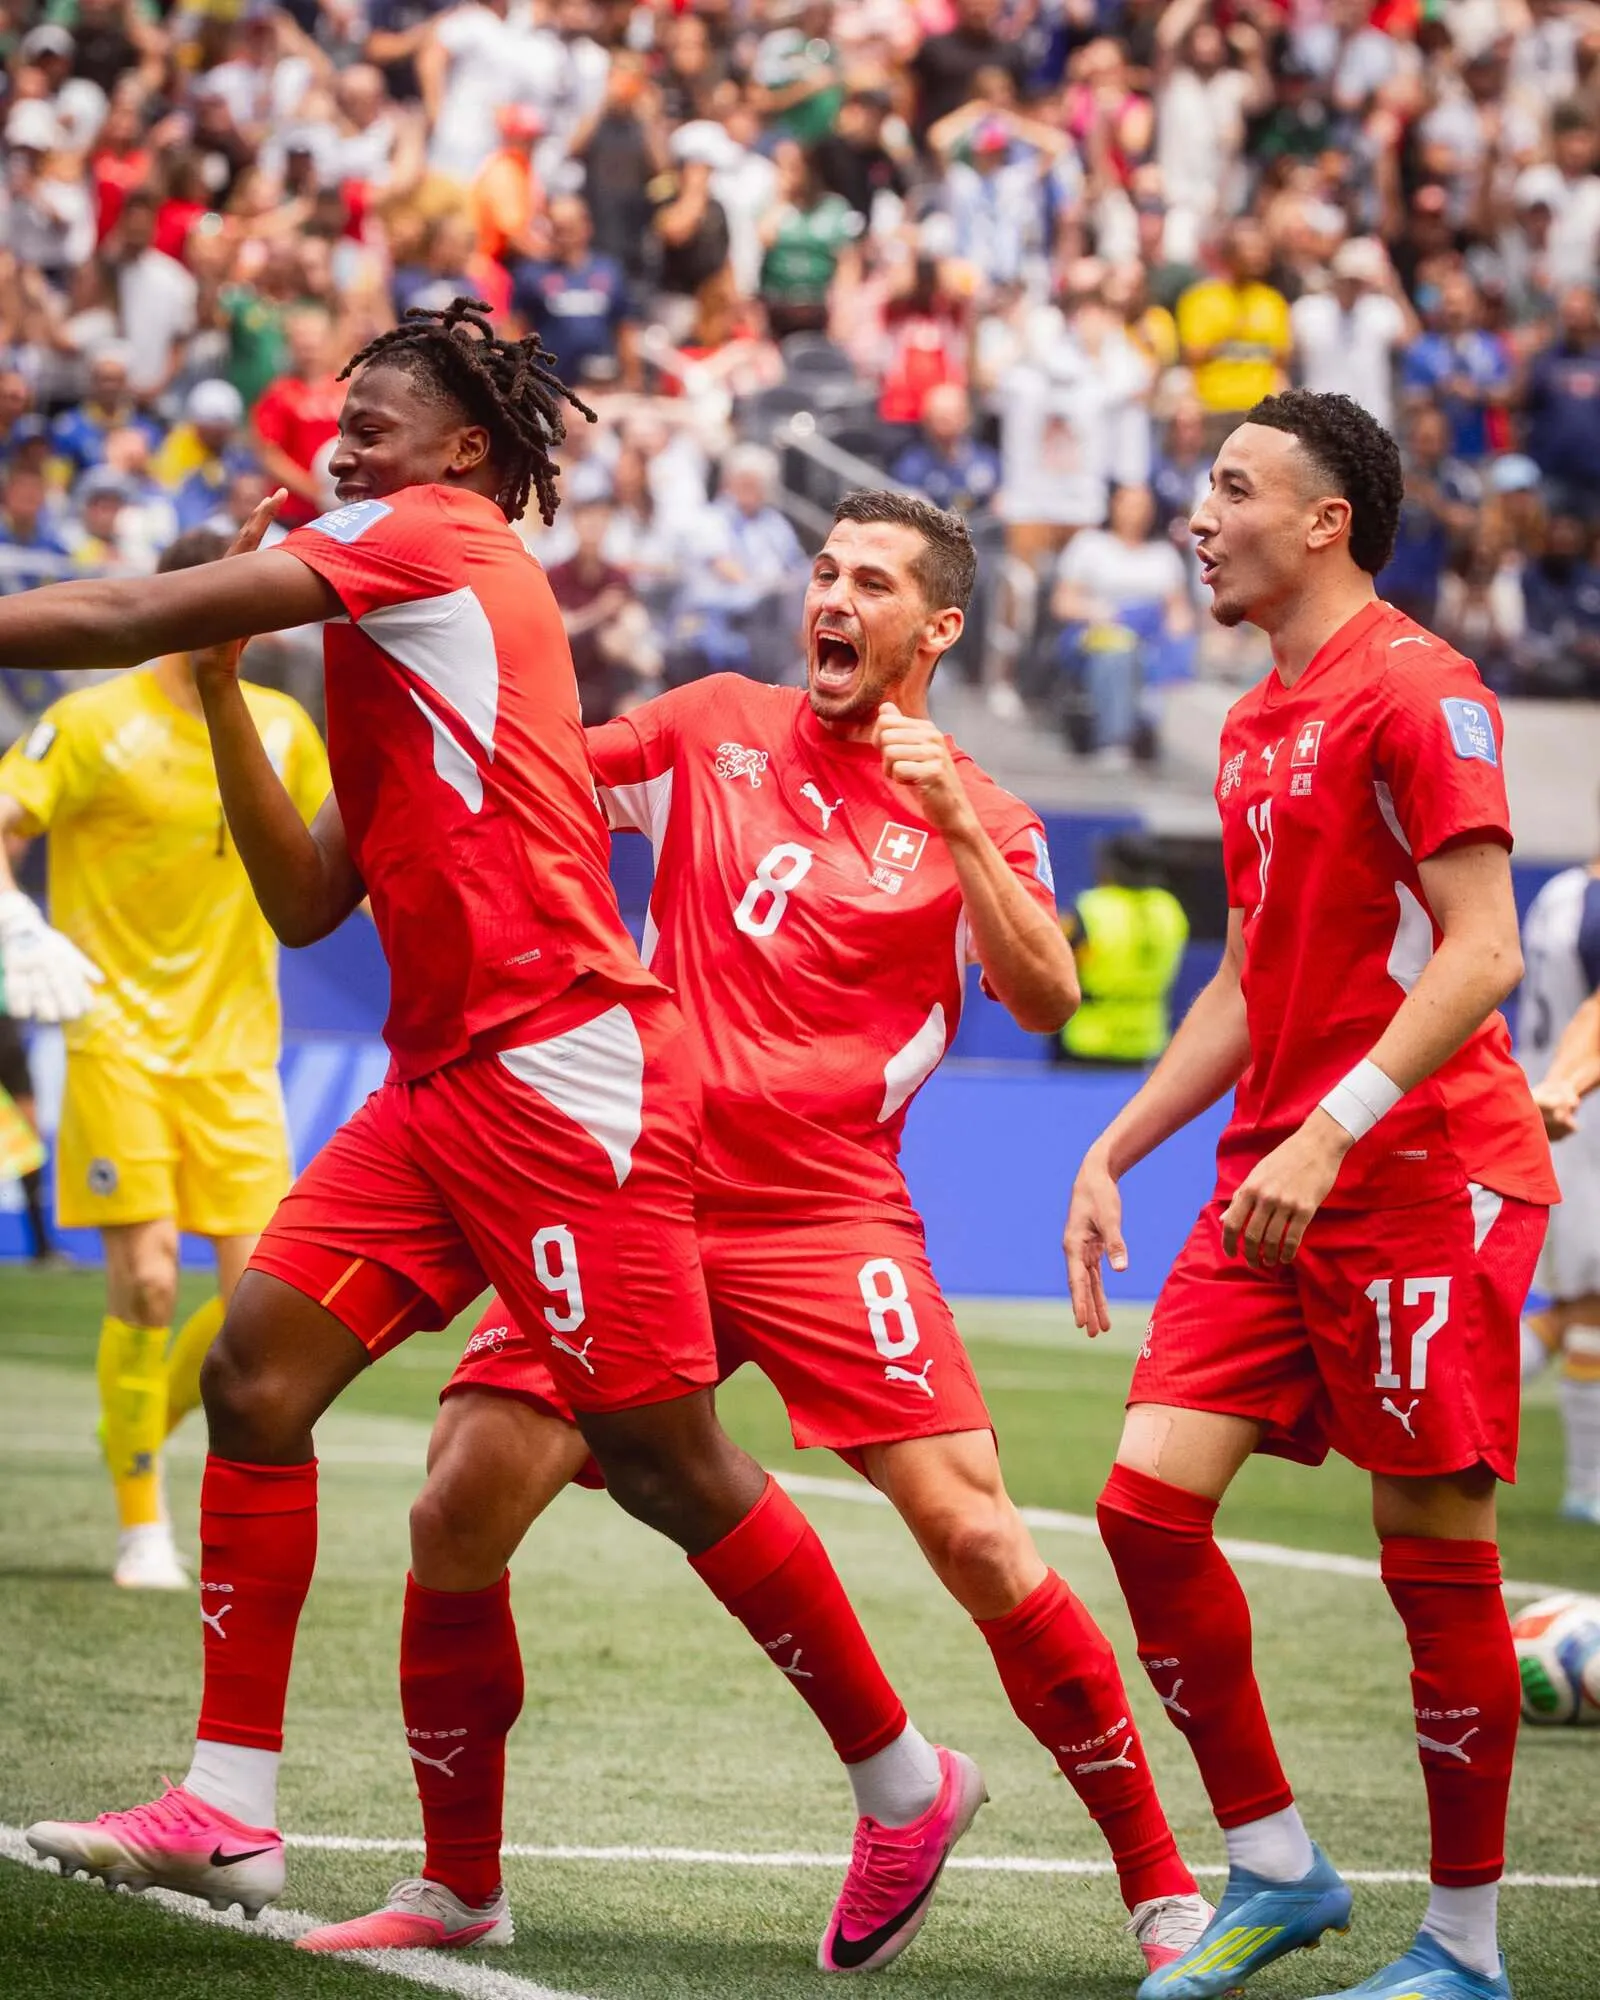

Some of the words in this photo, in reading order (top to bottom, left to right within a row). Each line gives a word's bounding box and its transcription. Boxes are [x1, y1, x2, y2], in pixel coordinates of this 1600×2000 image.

[733, 842, 815, 937] 8
[531, 1224, 585, 1332] 9
[857, 1257, 920, 1359] 8
[1364, 1276, 1453, 1389] 17
[1059, 1716, 1128, 1753] suisse
